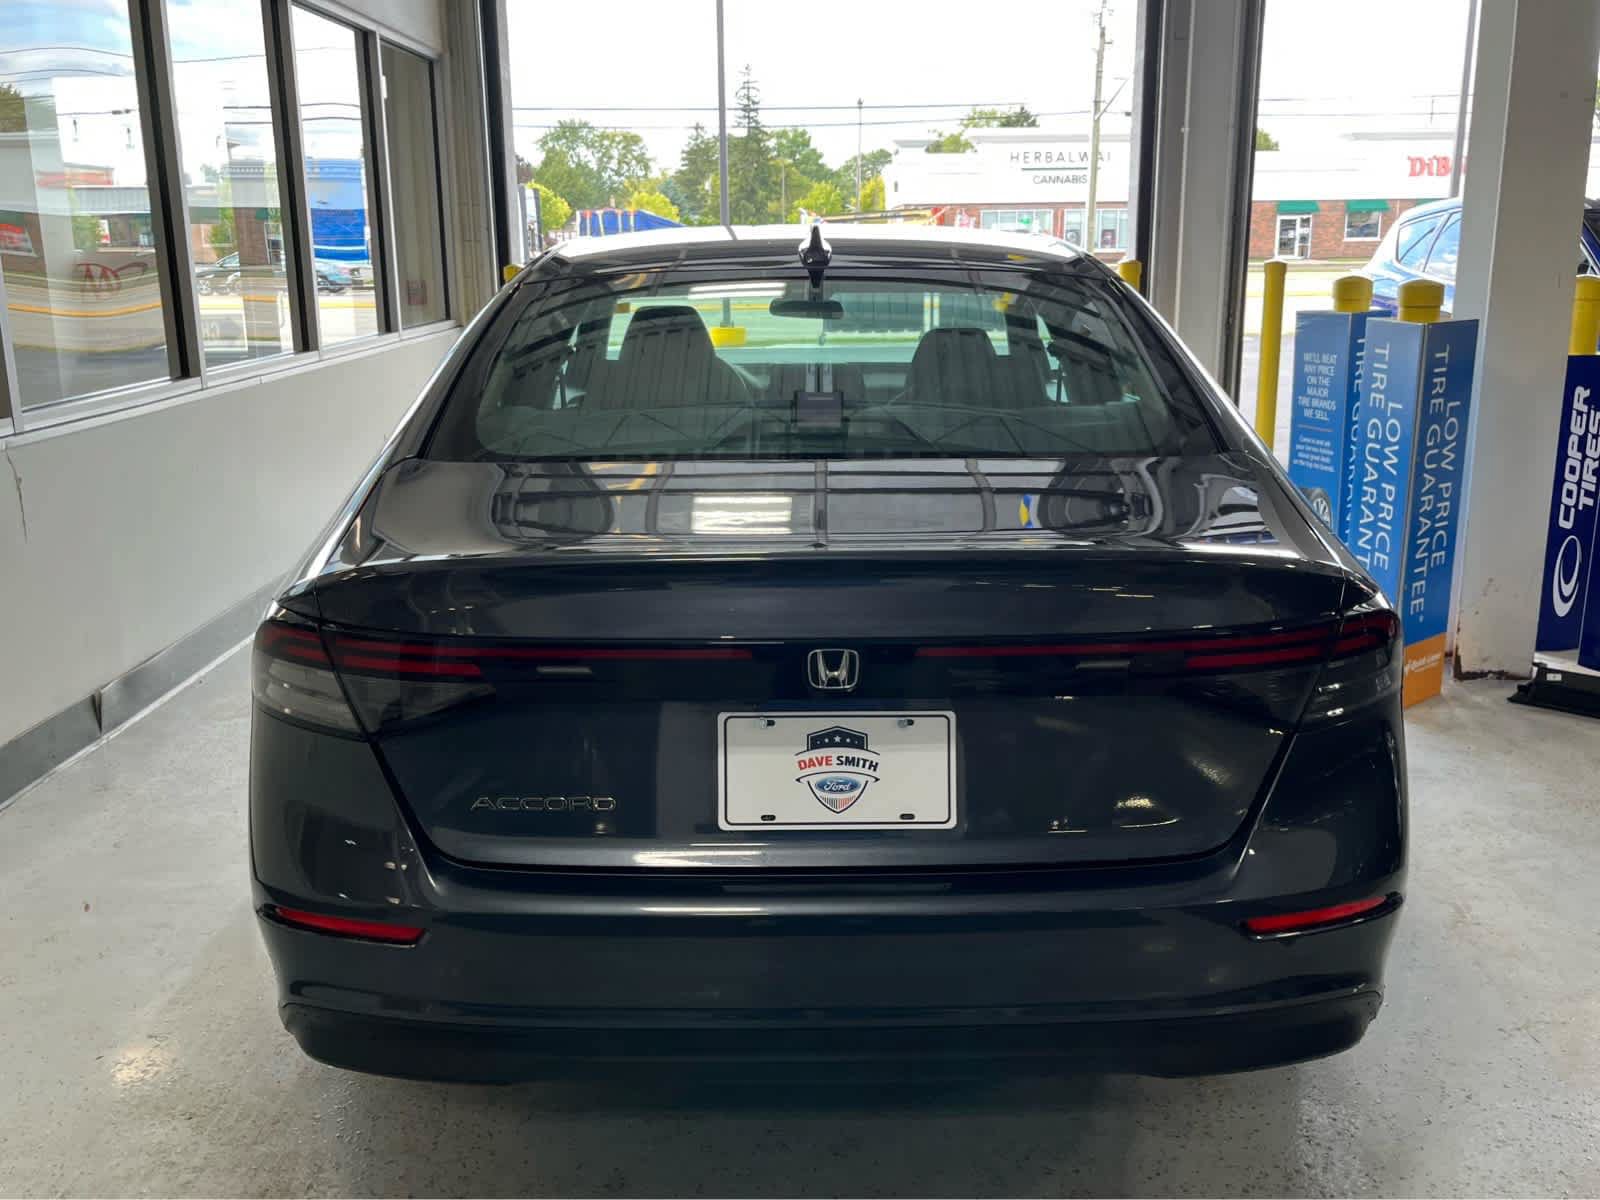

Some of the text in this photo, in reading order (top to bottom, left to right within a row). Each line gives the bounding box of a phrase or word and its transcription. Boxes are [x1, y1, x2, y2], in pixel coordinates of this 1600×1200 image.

[1032, 174, 1088, 185] CANNABIS
[1307, 375, 1330, 387] ON THE
[1429, 343, 1450, 415] TIRE
[1311, 397, 1336, 411] BRANDS
[1355, 342, 1390, 571] TIRE GUARANT
[1558, 385, 1591, 530] COOPER
[1578, 407, 1600, 511] TIRES
[1374, 401, 1403, 571] LOW PRICE
[1430, 401, 1461, 569] LOW PRICE
[798, 755, 879, 772] DAVE SMITH
[823, 780, 852, 791] Ford
[470, 796, 616, 811] ACCORD
